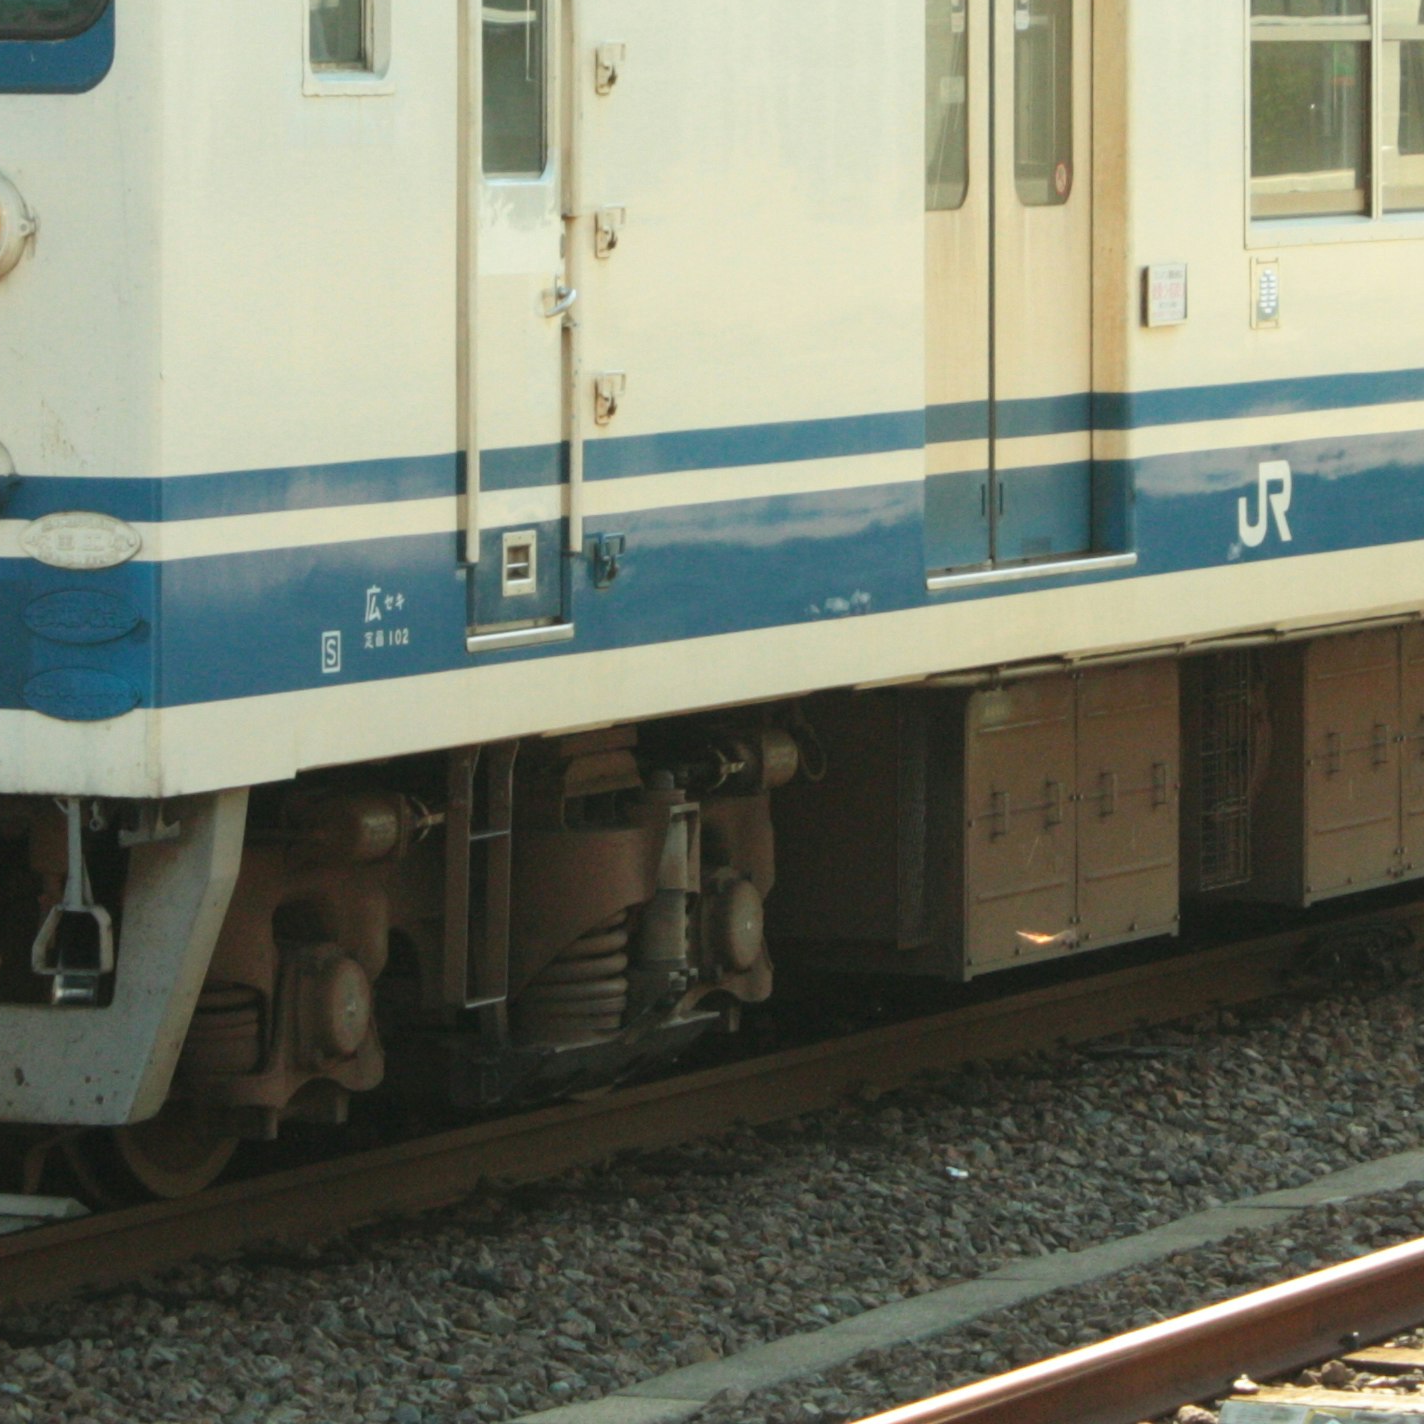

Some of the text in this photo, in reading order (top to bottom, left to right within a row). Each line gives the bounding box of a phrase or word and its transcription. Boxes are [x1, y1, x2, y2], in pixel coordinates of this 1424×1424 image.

[1238, 460, 1292, 548] JR
[389, 627, 409, 646] 102
[326, 638, 337, 666] S
